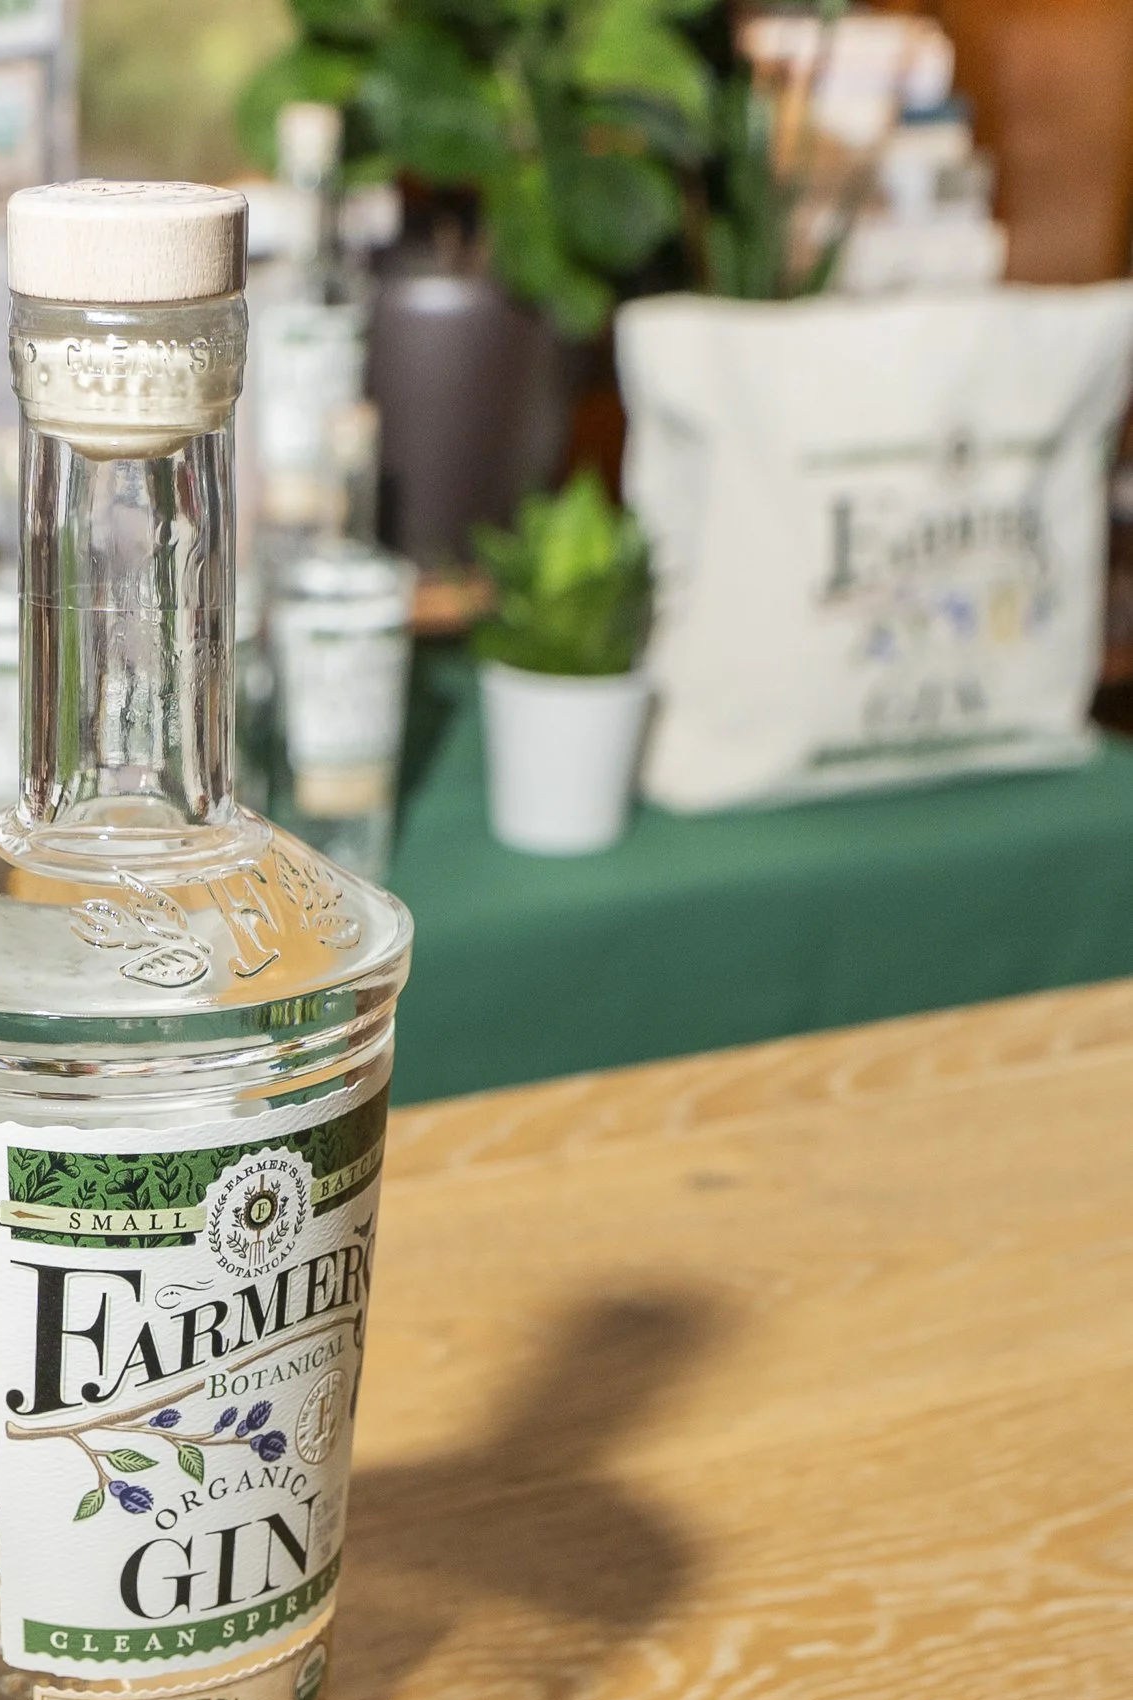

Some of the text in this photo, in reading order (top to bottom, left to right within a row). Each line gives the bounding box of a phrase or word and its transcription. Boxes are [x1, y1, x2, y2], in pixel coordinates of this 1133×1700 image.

[62, 336, 178, 378] CLEAN
[224, 1159, 299, 1193] FARMER'S
[69, 1212, 187, 1231] SMALL
[216, 1241, 296, 1279] BOTANICAL
[207, 1334, 345, 1401] BOTANICAL
[155, 1466, 308, 1530] ORGANIC
[119, 1490, 322, 1620] GIN
[49, 1629, 196, 1653] CLEAN
